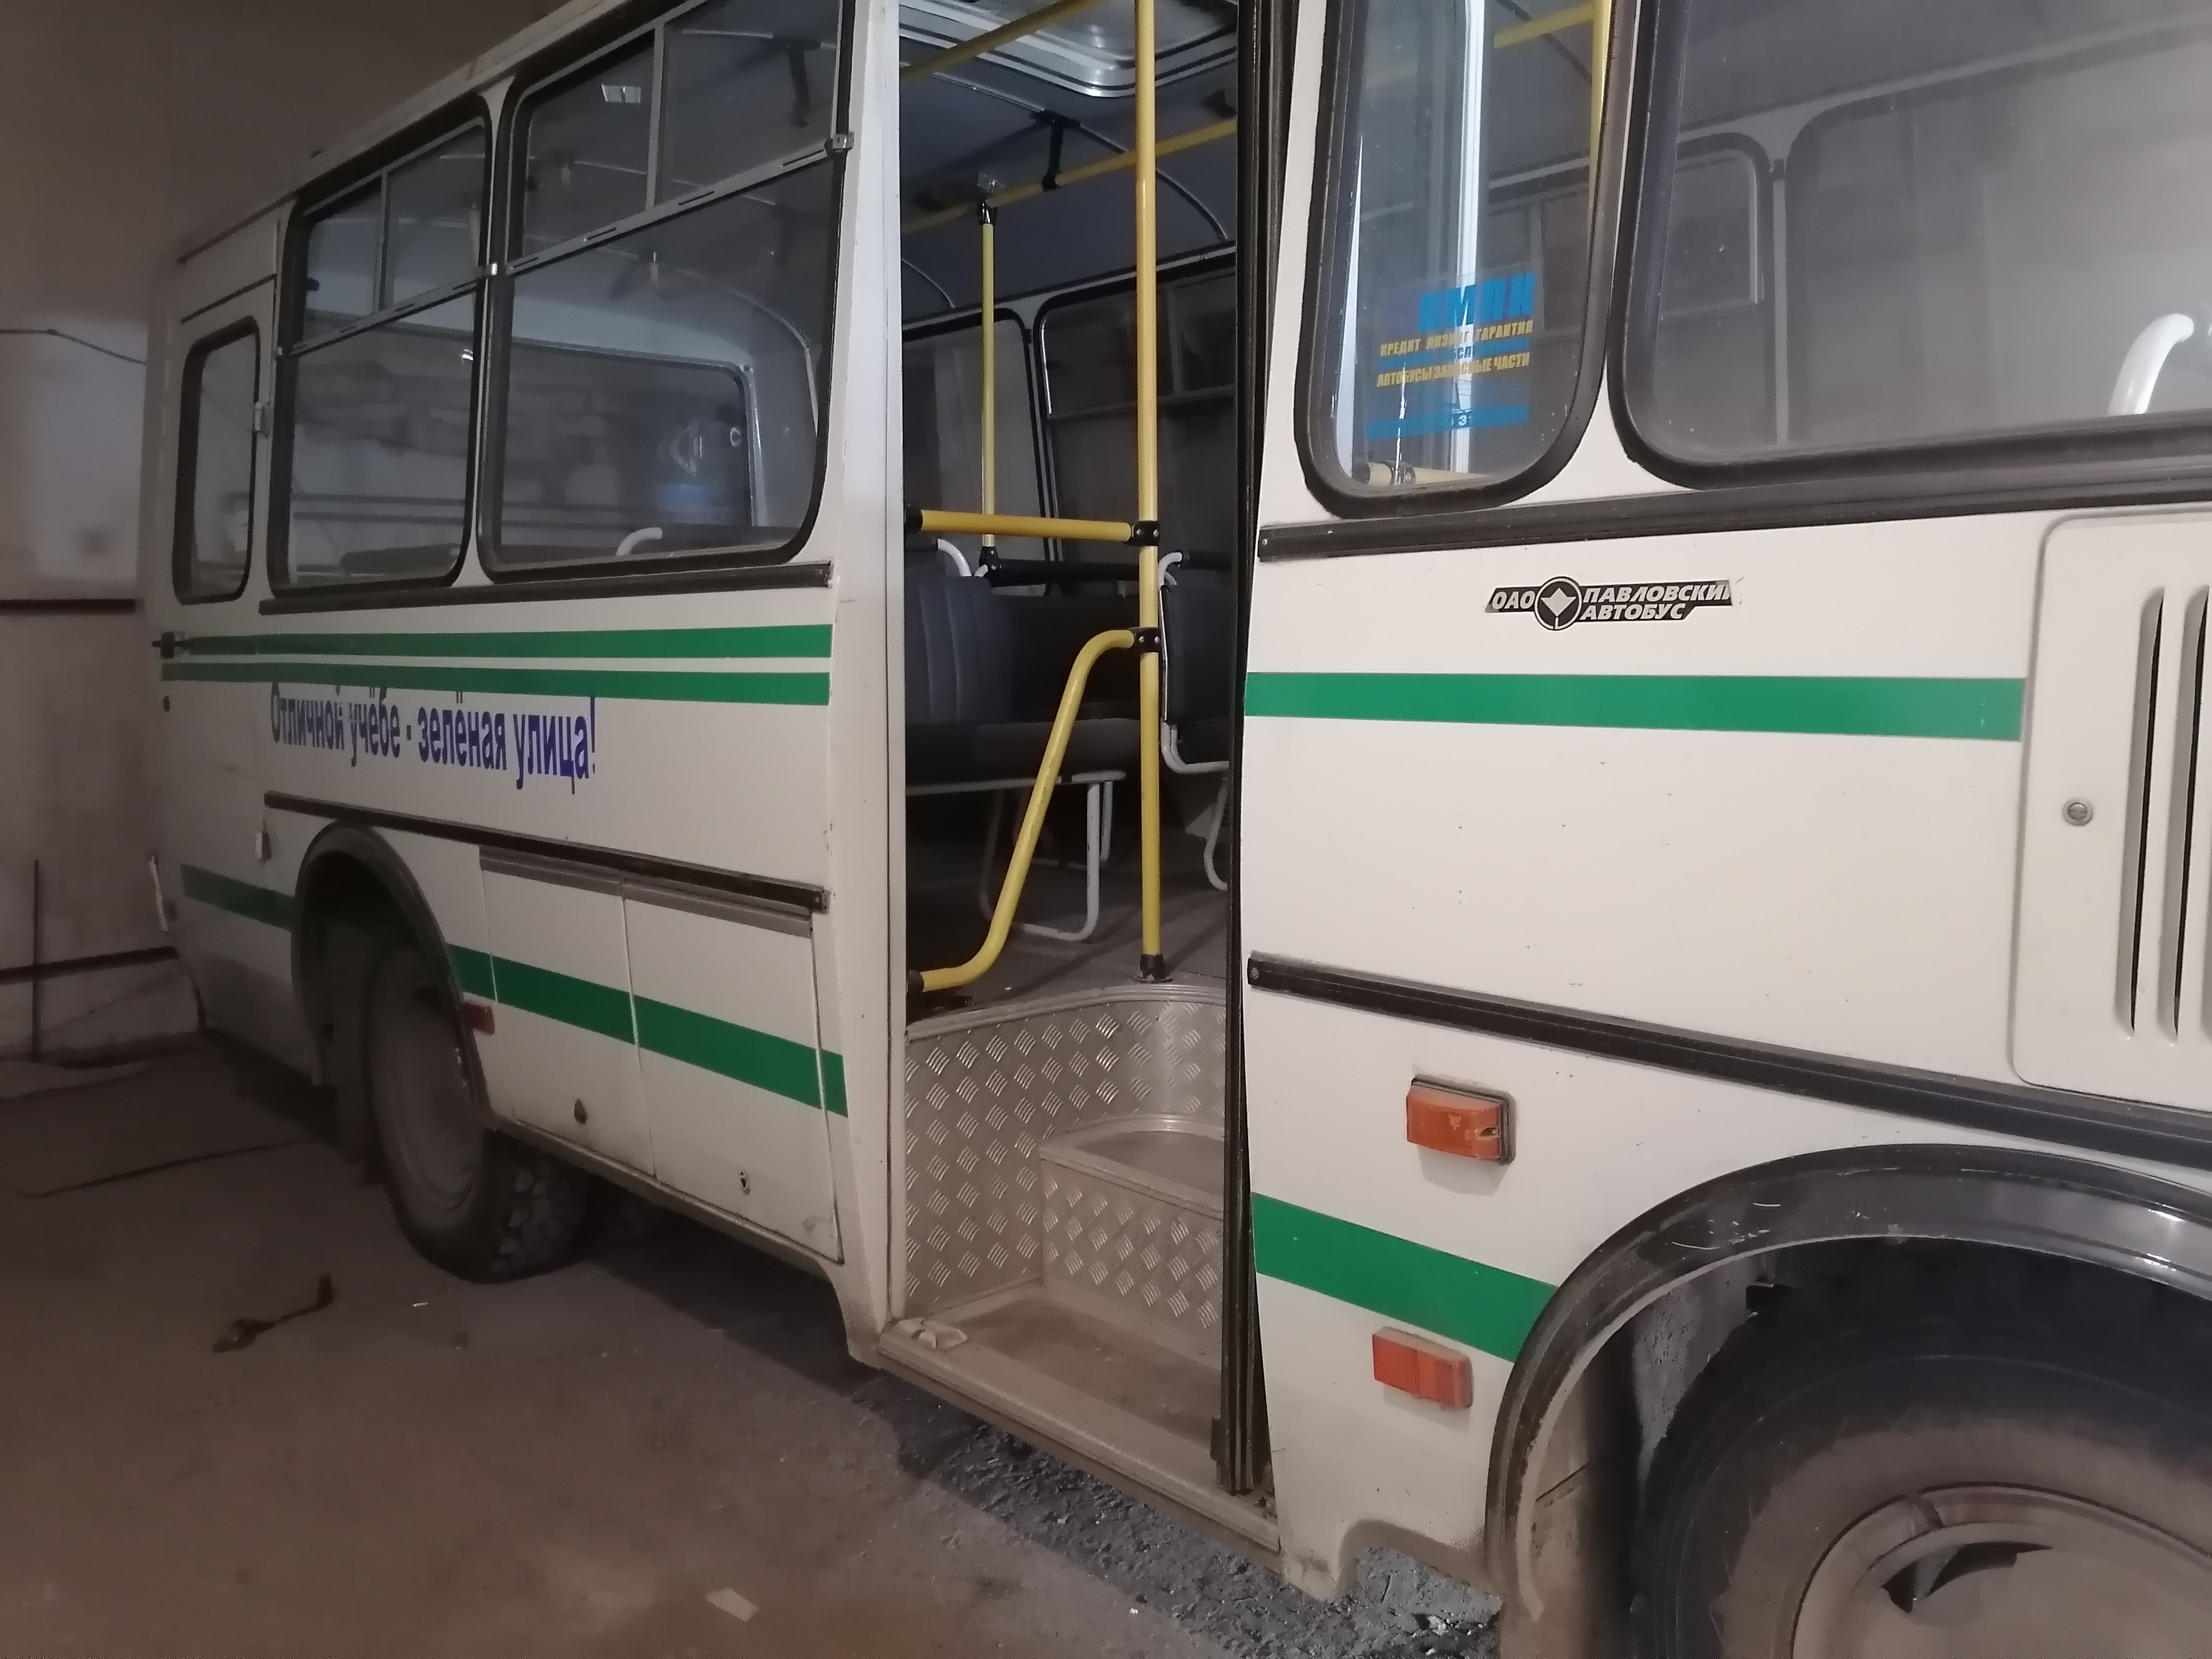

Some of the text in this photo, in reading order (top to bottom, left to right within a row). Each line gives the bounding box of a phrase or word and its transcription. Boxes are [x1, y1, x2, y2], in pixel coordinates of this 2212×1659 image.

[1380, 338, 1422, 357] КРЕДИТ
[1426, 331, 1469, 351] ЛИЗГ
[1476, 320, 1534, 342] ГАРАНТИЯ
[1377, 367, 1432, 388] АВТОБУСЫ
[1434, 356, 1492, 380] ЗАСНЫЕ
[1494, 352, 1530, 371] ЧАСТИ
[1493, 590, 1536, 610] ОАО
[1580, 603, 1686, 620] АВТОБУС
[270, 682, 345, 750] Отличной
[349, 686, 400, 767] учёбе
[418, 691, 507, 770] зелёная
[513, 696, 596, 795] улица!
